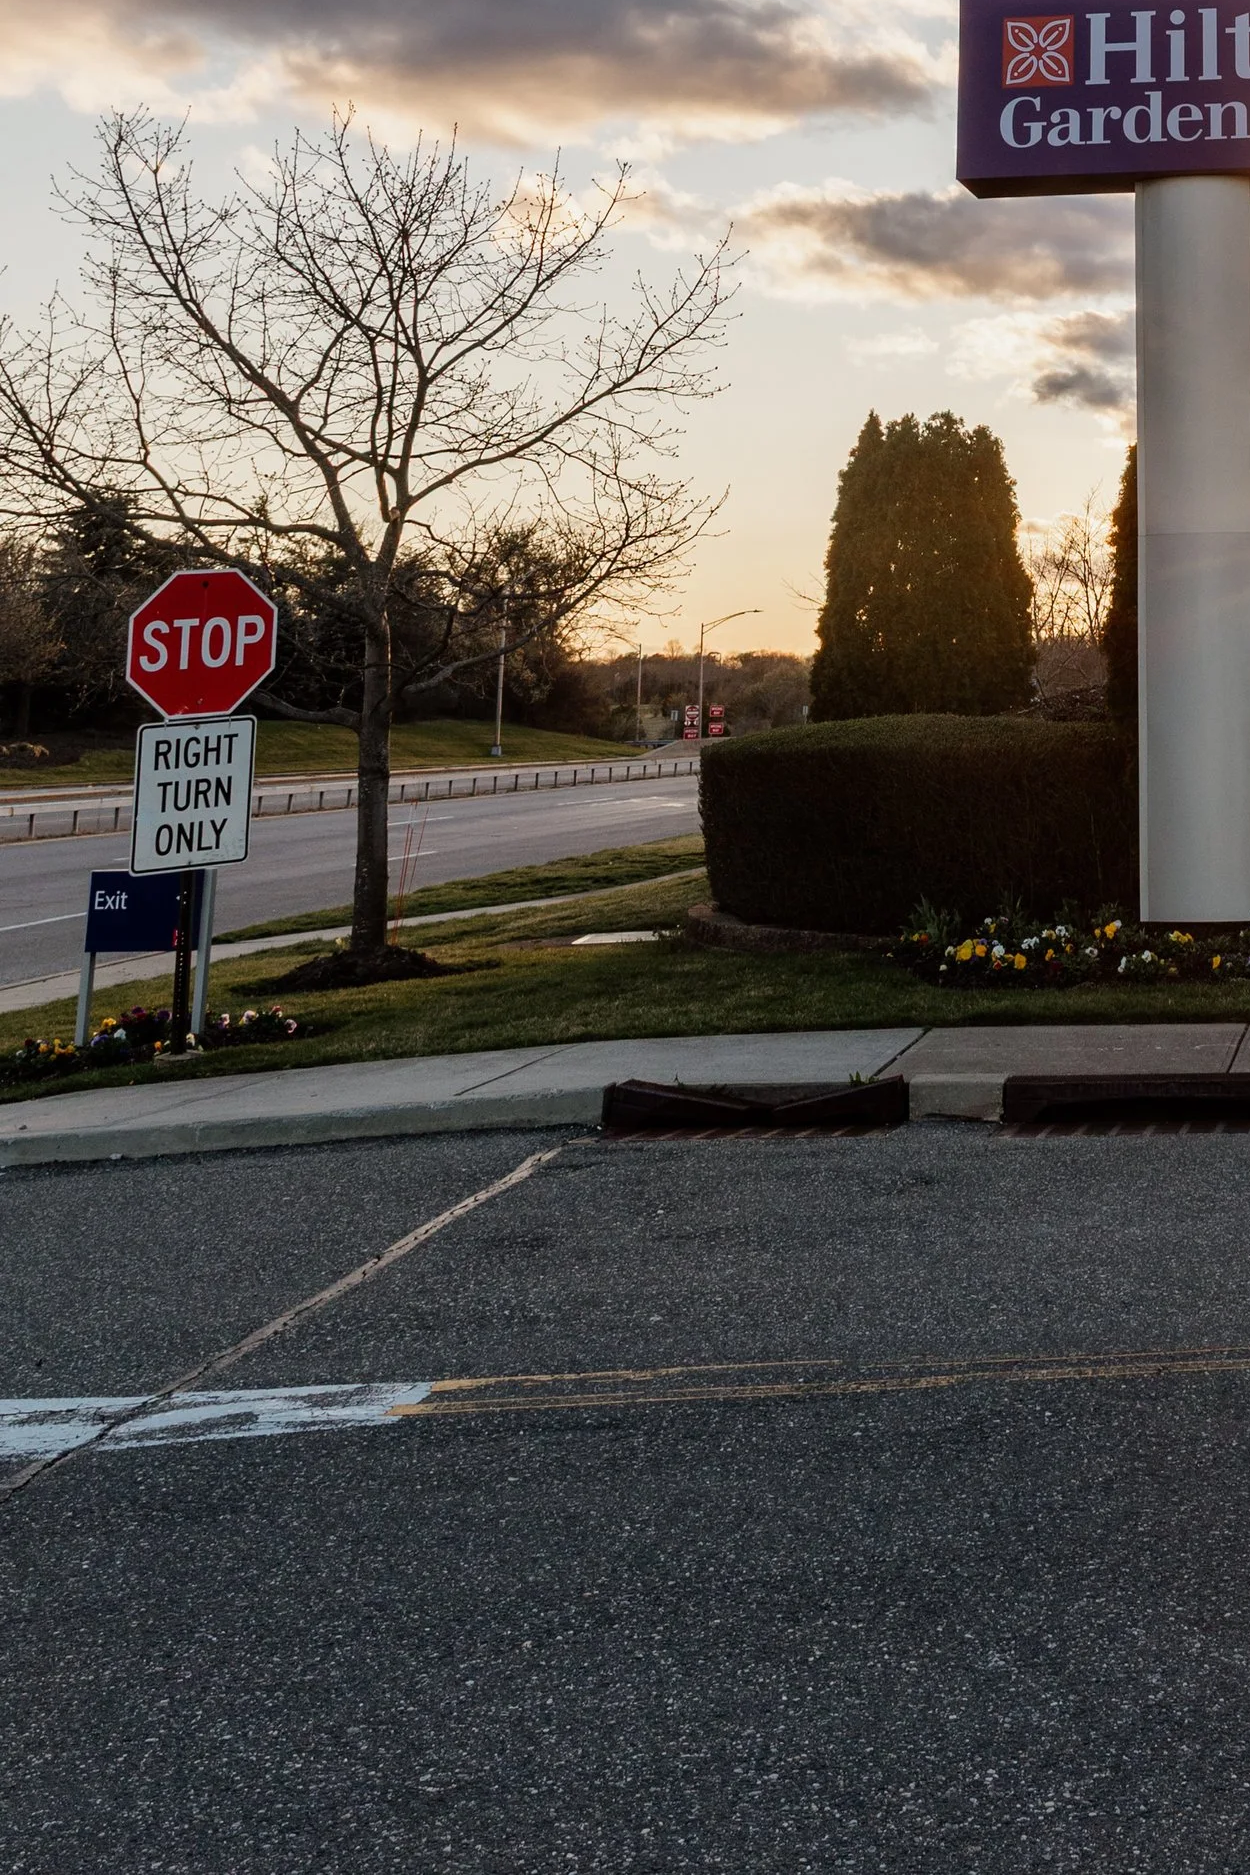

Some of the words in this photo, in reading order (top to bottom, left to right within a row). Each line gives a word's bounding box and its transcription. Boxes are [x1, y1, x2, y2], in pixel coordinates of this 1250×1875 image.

[139, 615, 265, 672] STOP
[154, 733, 239, 771] RIGHT
[157, 776, 232, 813] TURN
[155, 818, 228, 856] ONLY
[94, 890, 128, 910] Exit
